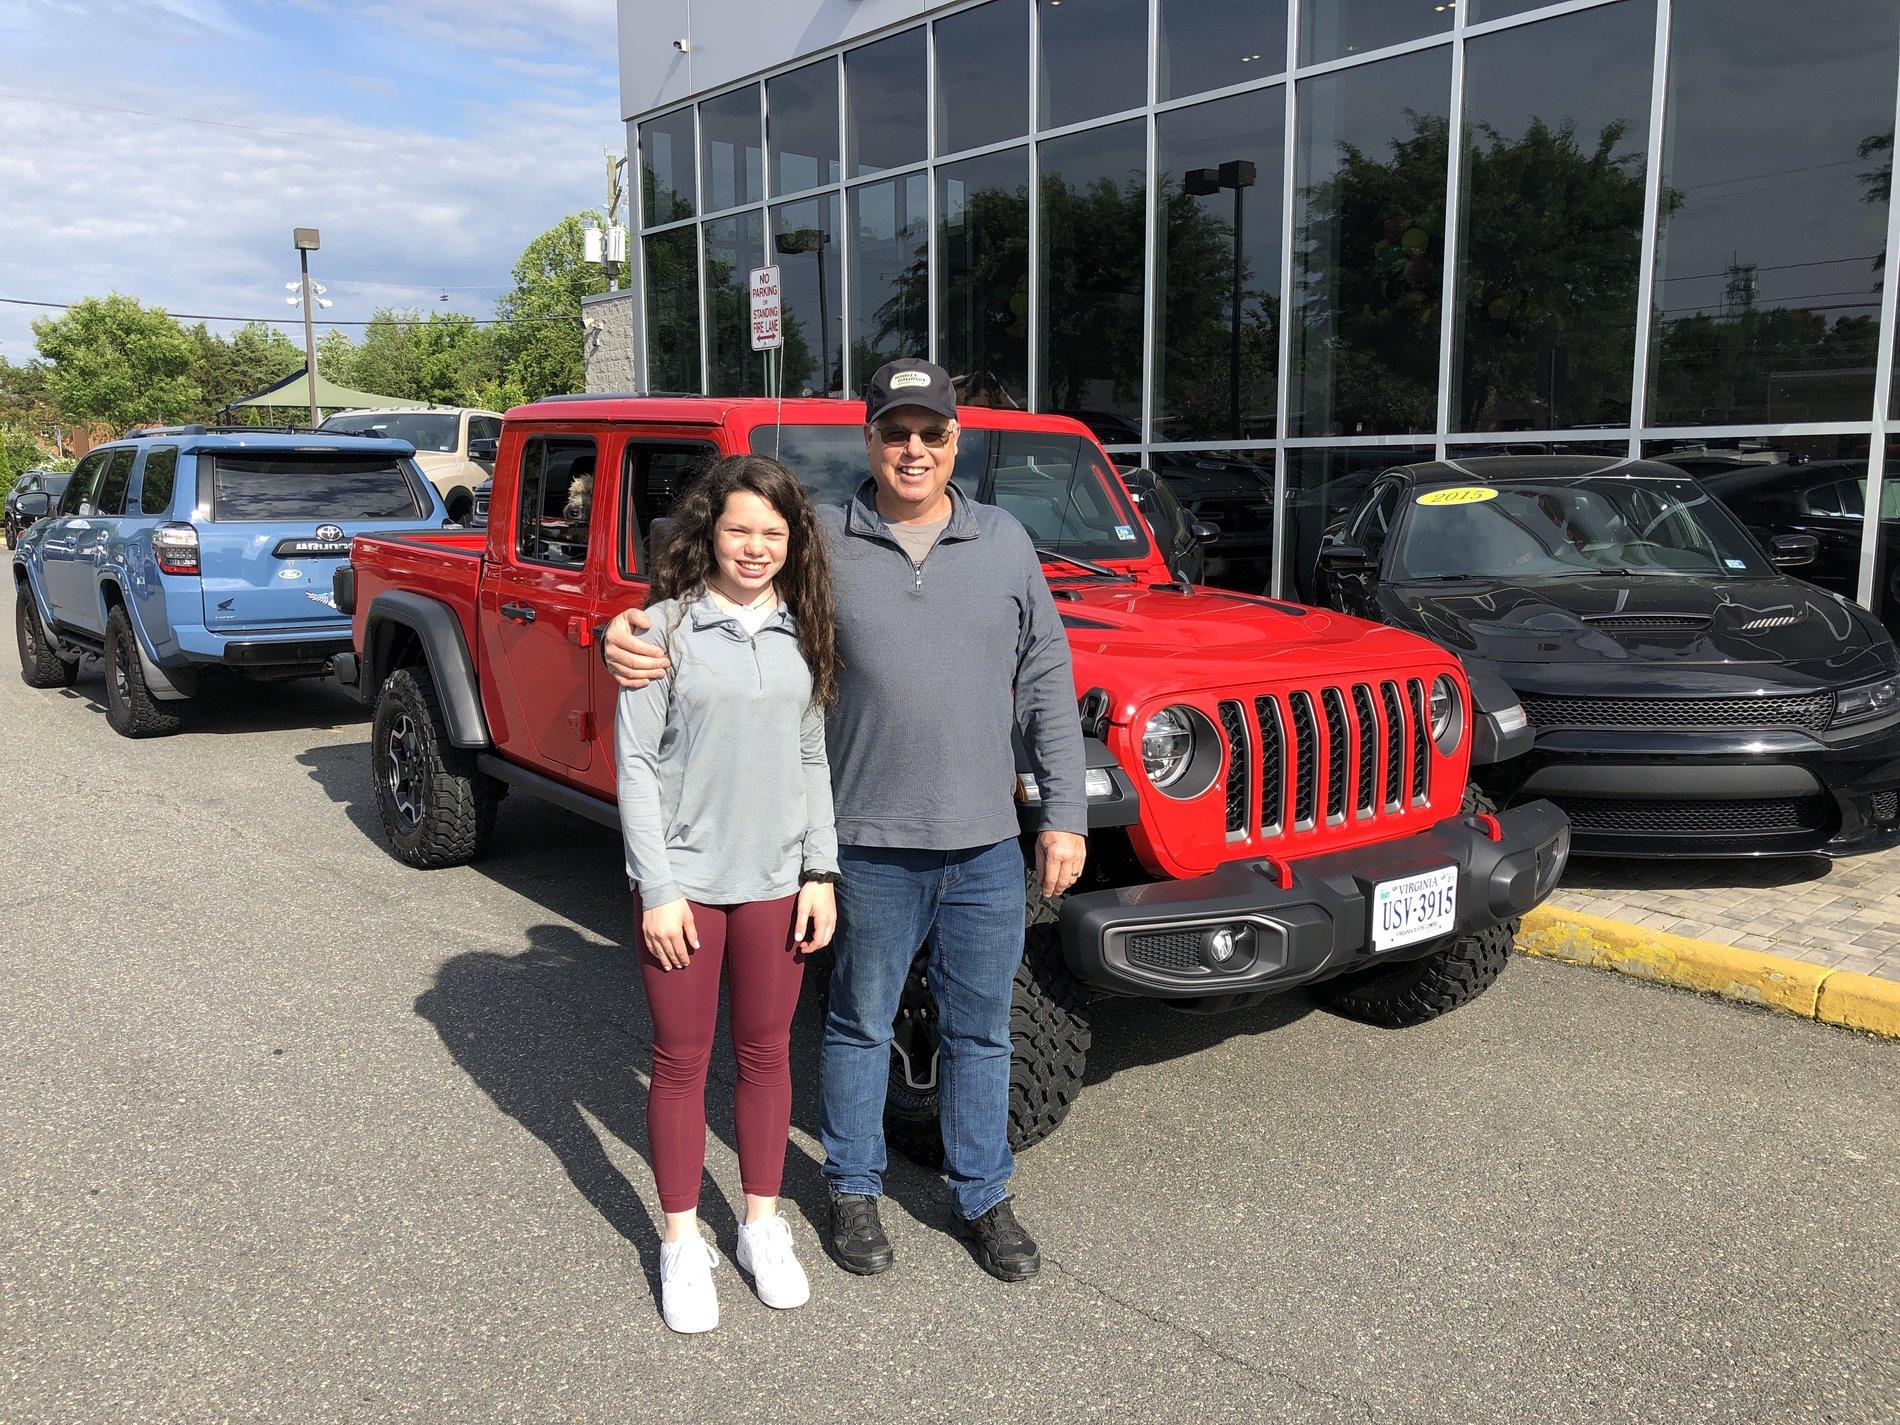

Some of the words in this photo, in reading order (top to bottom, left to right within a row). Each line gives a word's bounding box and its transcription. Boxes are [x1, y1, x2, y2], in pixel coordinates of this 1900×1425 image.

[759, 273, 769, 284] NO
[752, 285, 777, 298] PARKING
[753, 307, 778, 319] STANDING
[753, 321, 764, 334] FIRE
[765, 320, 778, 332] LANE
[1431, 490, 1484, 503] 2015
[1399, 877, 1438, 894] VIRGINIA
